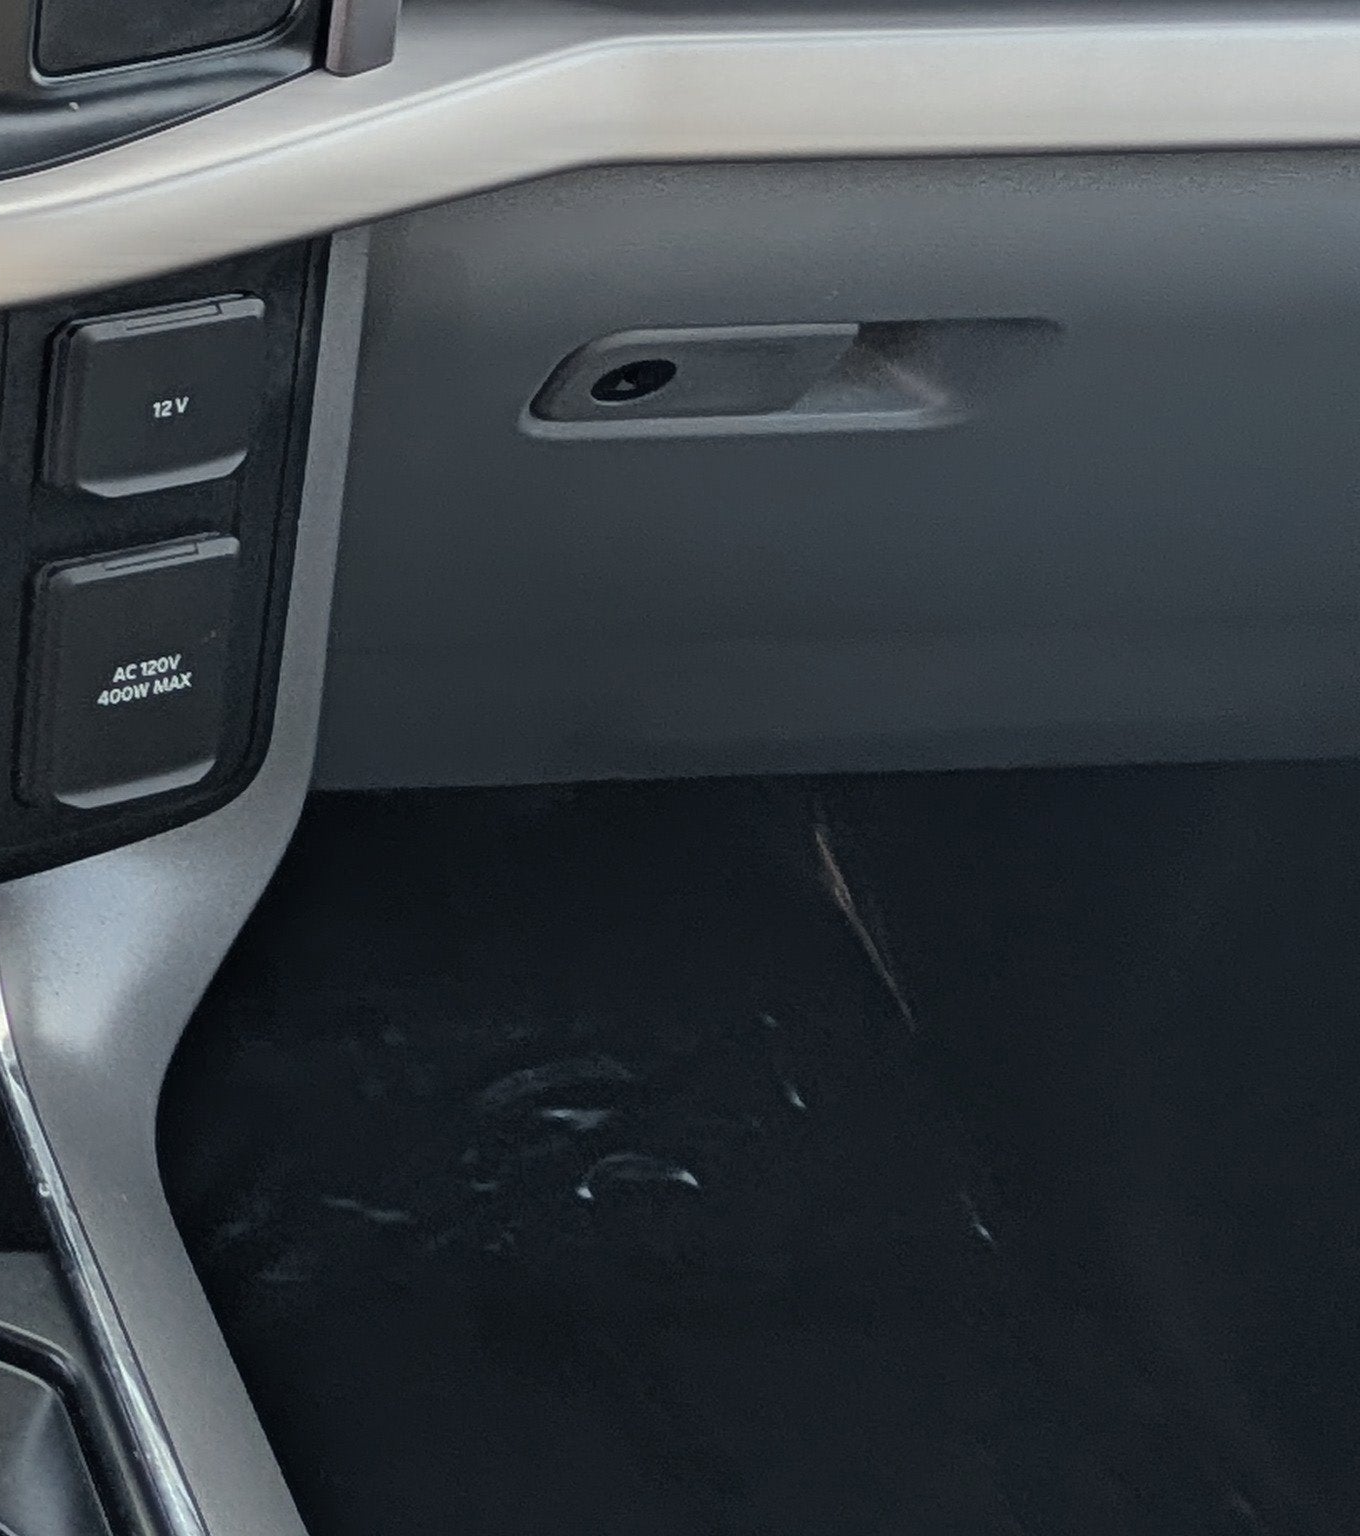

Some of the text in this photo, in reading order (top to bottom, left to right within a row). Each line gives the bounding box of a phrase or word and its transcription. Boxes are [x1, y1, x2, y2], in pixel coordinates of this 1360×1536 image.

[112, 654, 182, 683] AC 120V
[97, 671, 192, 707] 400W MAX
